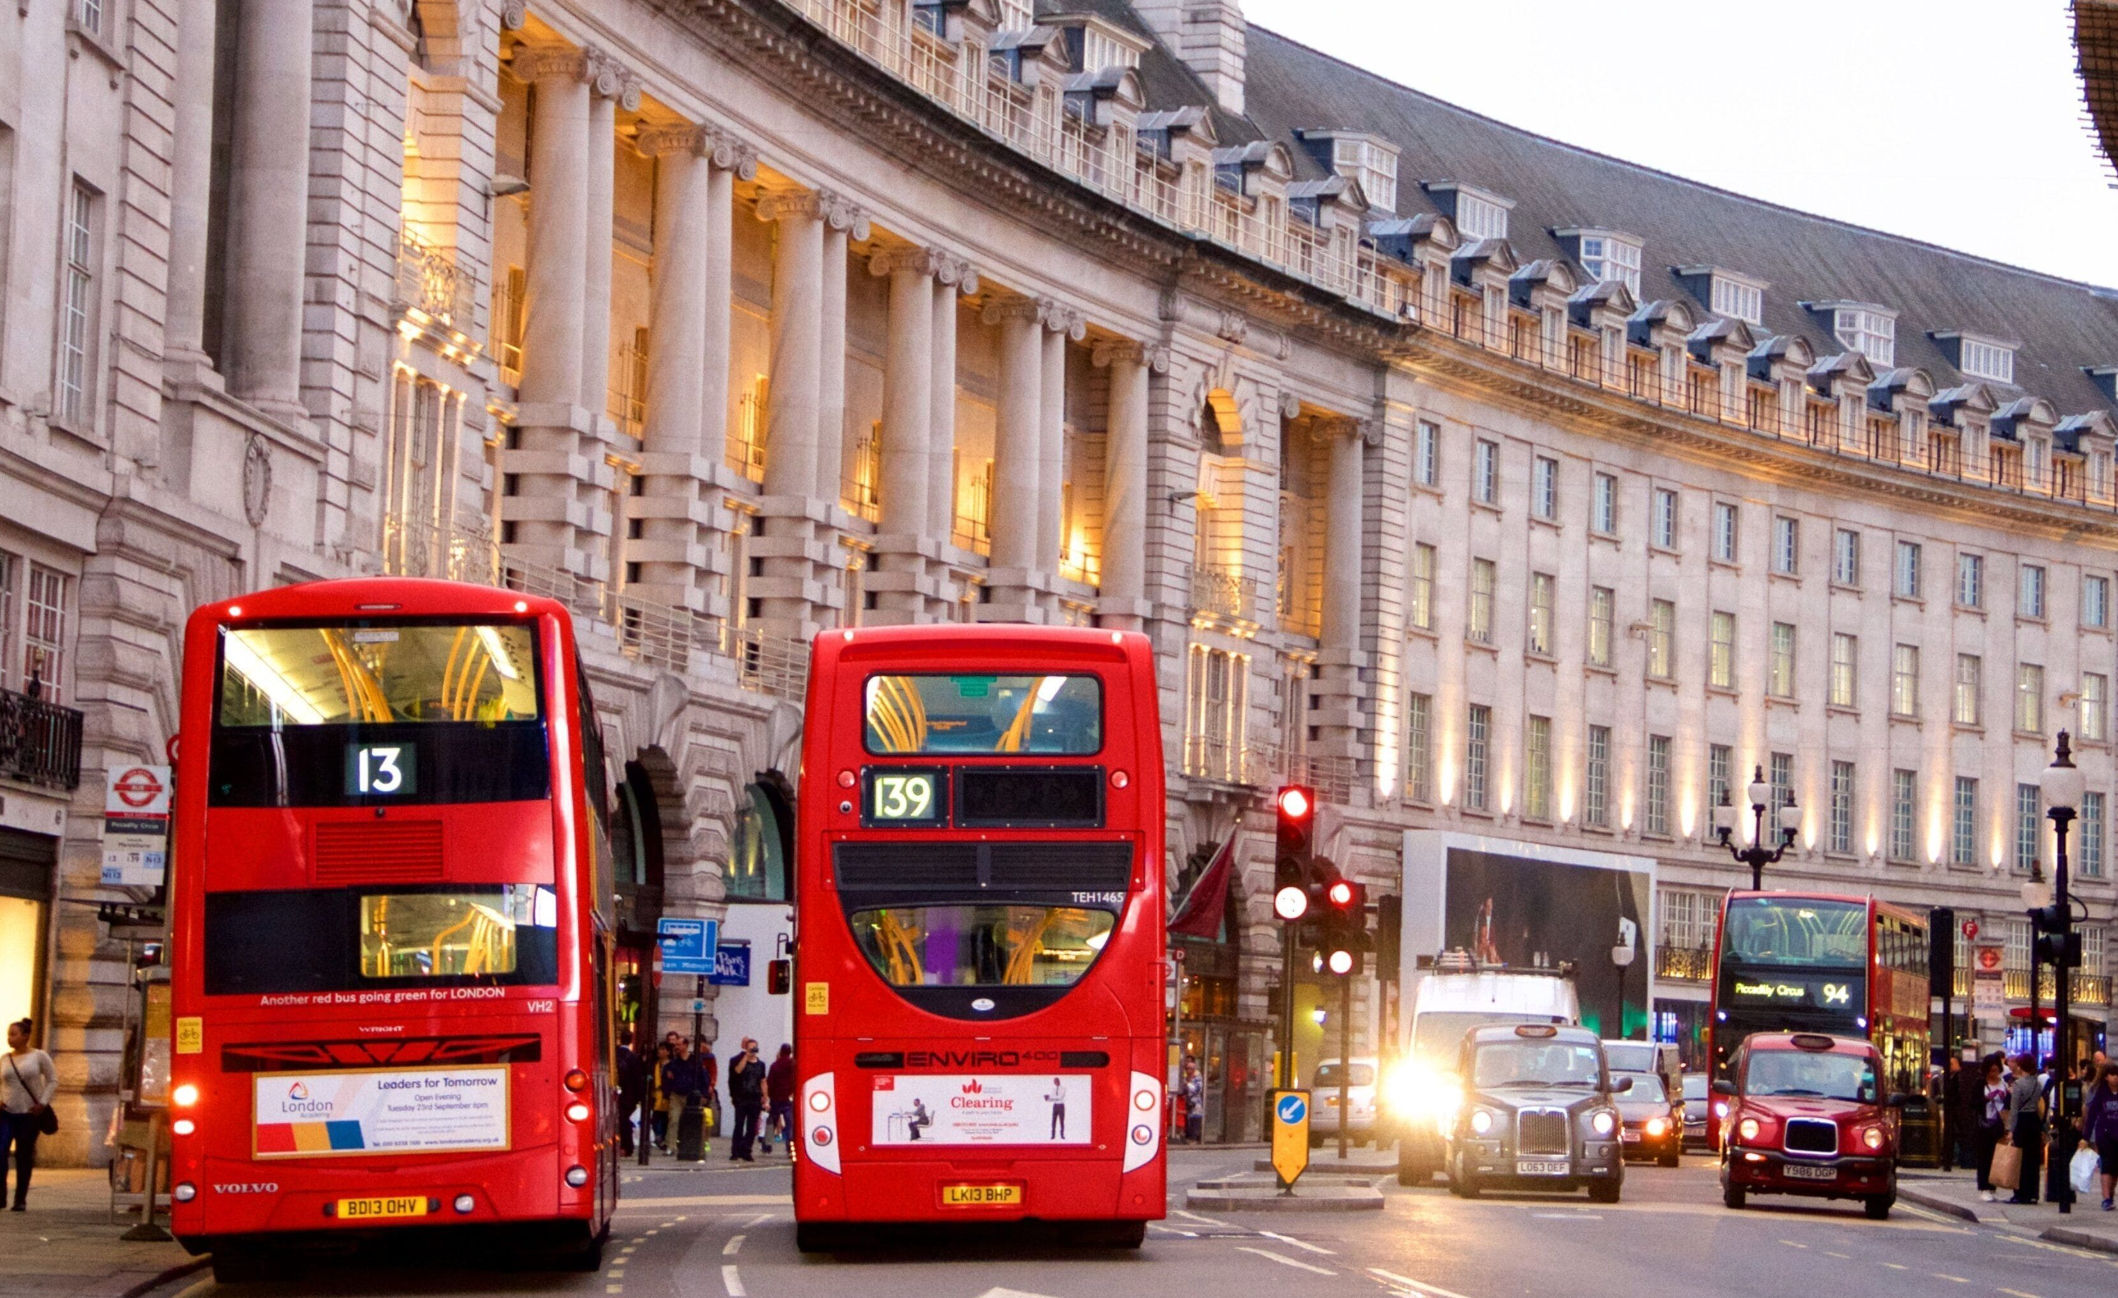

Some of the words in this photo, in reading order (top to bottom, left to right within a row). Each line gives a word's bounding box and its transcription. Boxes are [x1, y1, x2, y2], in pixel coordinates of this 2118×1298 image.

[359, 747, 402, 792] 13
[875, 776, 931, 817] 139
[1071, 891, 1124, 903] TEH1465
[1966, 924, 1974, 934] F
[1176, 950, 1185, 960] D
[261, 995, 309, 1005] Another
[312, 993, 332, 1003] red
[335, 992, 356, 1003] bus
[359, 991, 391, 1004] going
[394, 991, 427, 1003] green
[430, 989, 447, 1000] for
[451, 987, 505, 999] LONDON
[1735, 983, 1775, 997] Piccadilly
[1777, 985, 1805, 997] Circus
[1823, 984, 1850, 1004] 94
[527, 1001, 553, 1013] VH2
[377, 1079, 421, 1090] Leaders
[424, 1078, 440, 1088] for
[443, 1076, 498, 1087] Tomorrow
[414, 1093, 434, 1102] Open
[435, 1093, 461, 1101] Evening
[951, 1096, 1014, 1111] Clearing
[282, 1099, 333, 1113] London
[435, 1102, 471, 1111] September
[213, 1183, 279, 1194] VOLVO
[951, 1188, 982, 1202] LK13
[986, 1188, 1012, 1201] BHP
[348, 1200, 382, 1216] BD13
[386, 1199, 417, 1214] OHV
